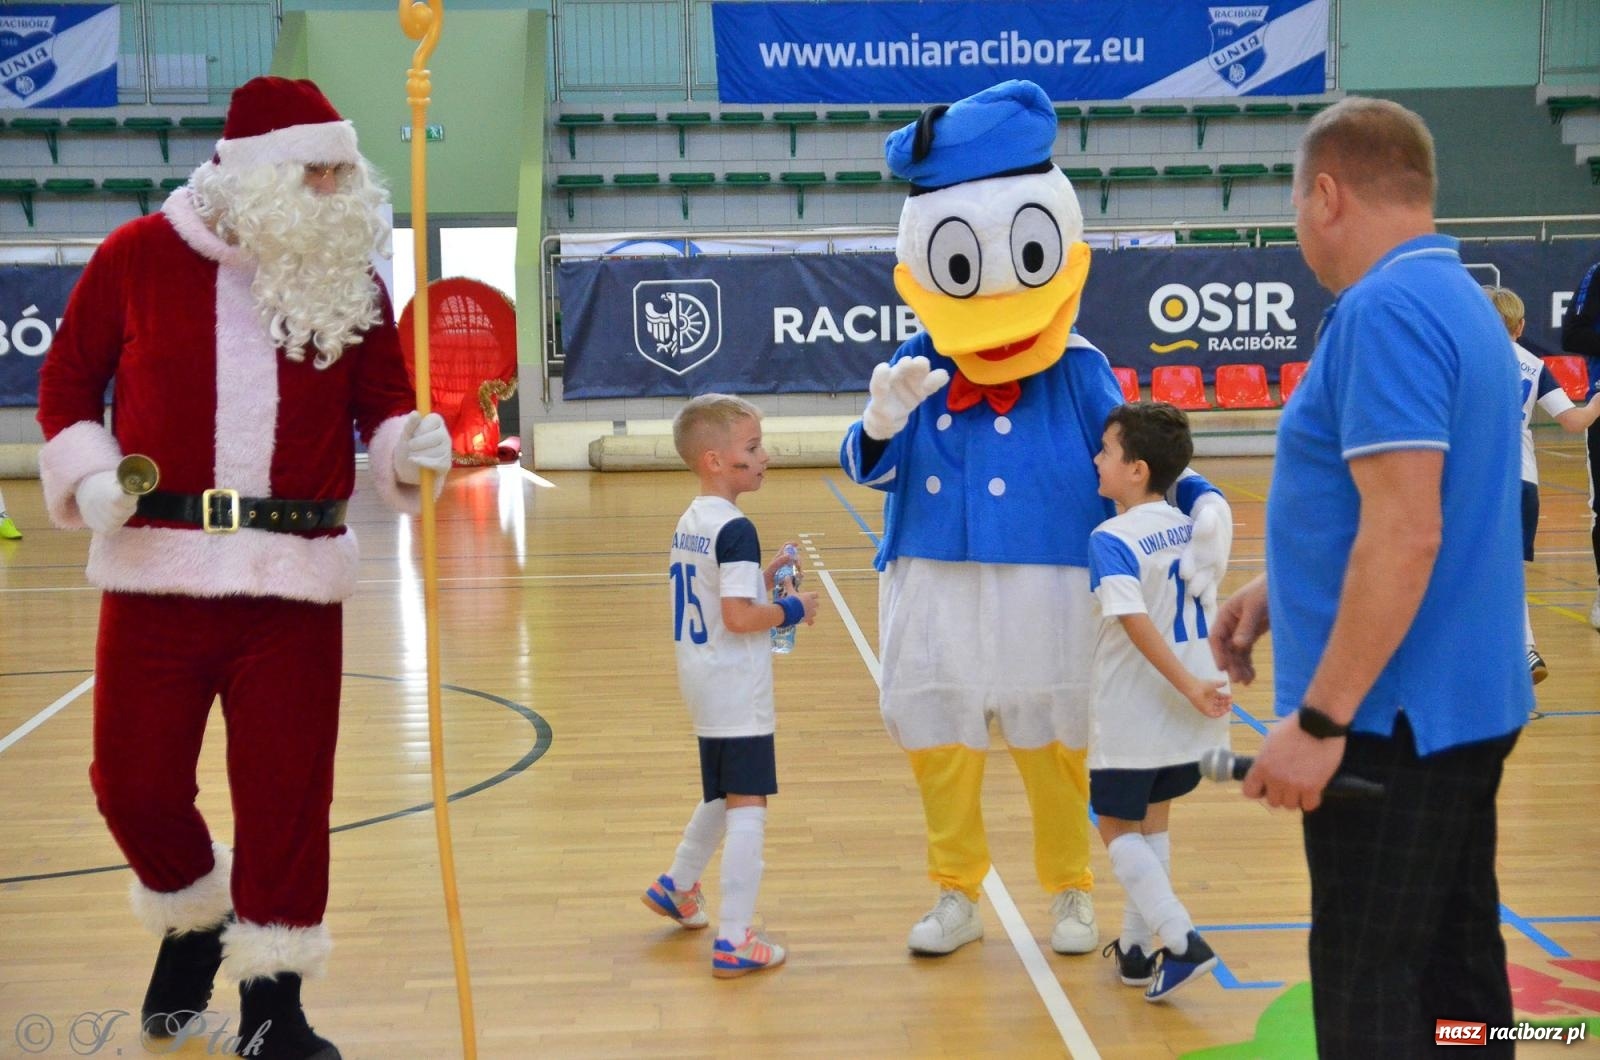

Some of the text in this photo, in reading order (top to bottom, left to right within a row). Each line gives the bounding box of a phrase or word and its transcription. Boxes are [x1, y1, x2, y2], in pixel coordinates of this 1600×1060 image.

[0, 19, 49, 28] ACIBÓRZ
[0, 46, 48, 77] UNIA
[759, 31, 1145, 68] www.uniaraciborz.eu
[1213, 34, 1259, 66] UNIA
[773, 305, 925, 344] RACIB
[1207, 332, 1297, 351] RACIBÓRZ
[1138, 531, 1168, 556] UNIA
[670, 562, 708, 645] 15
